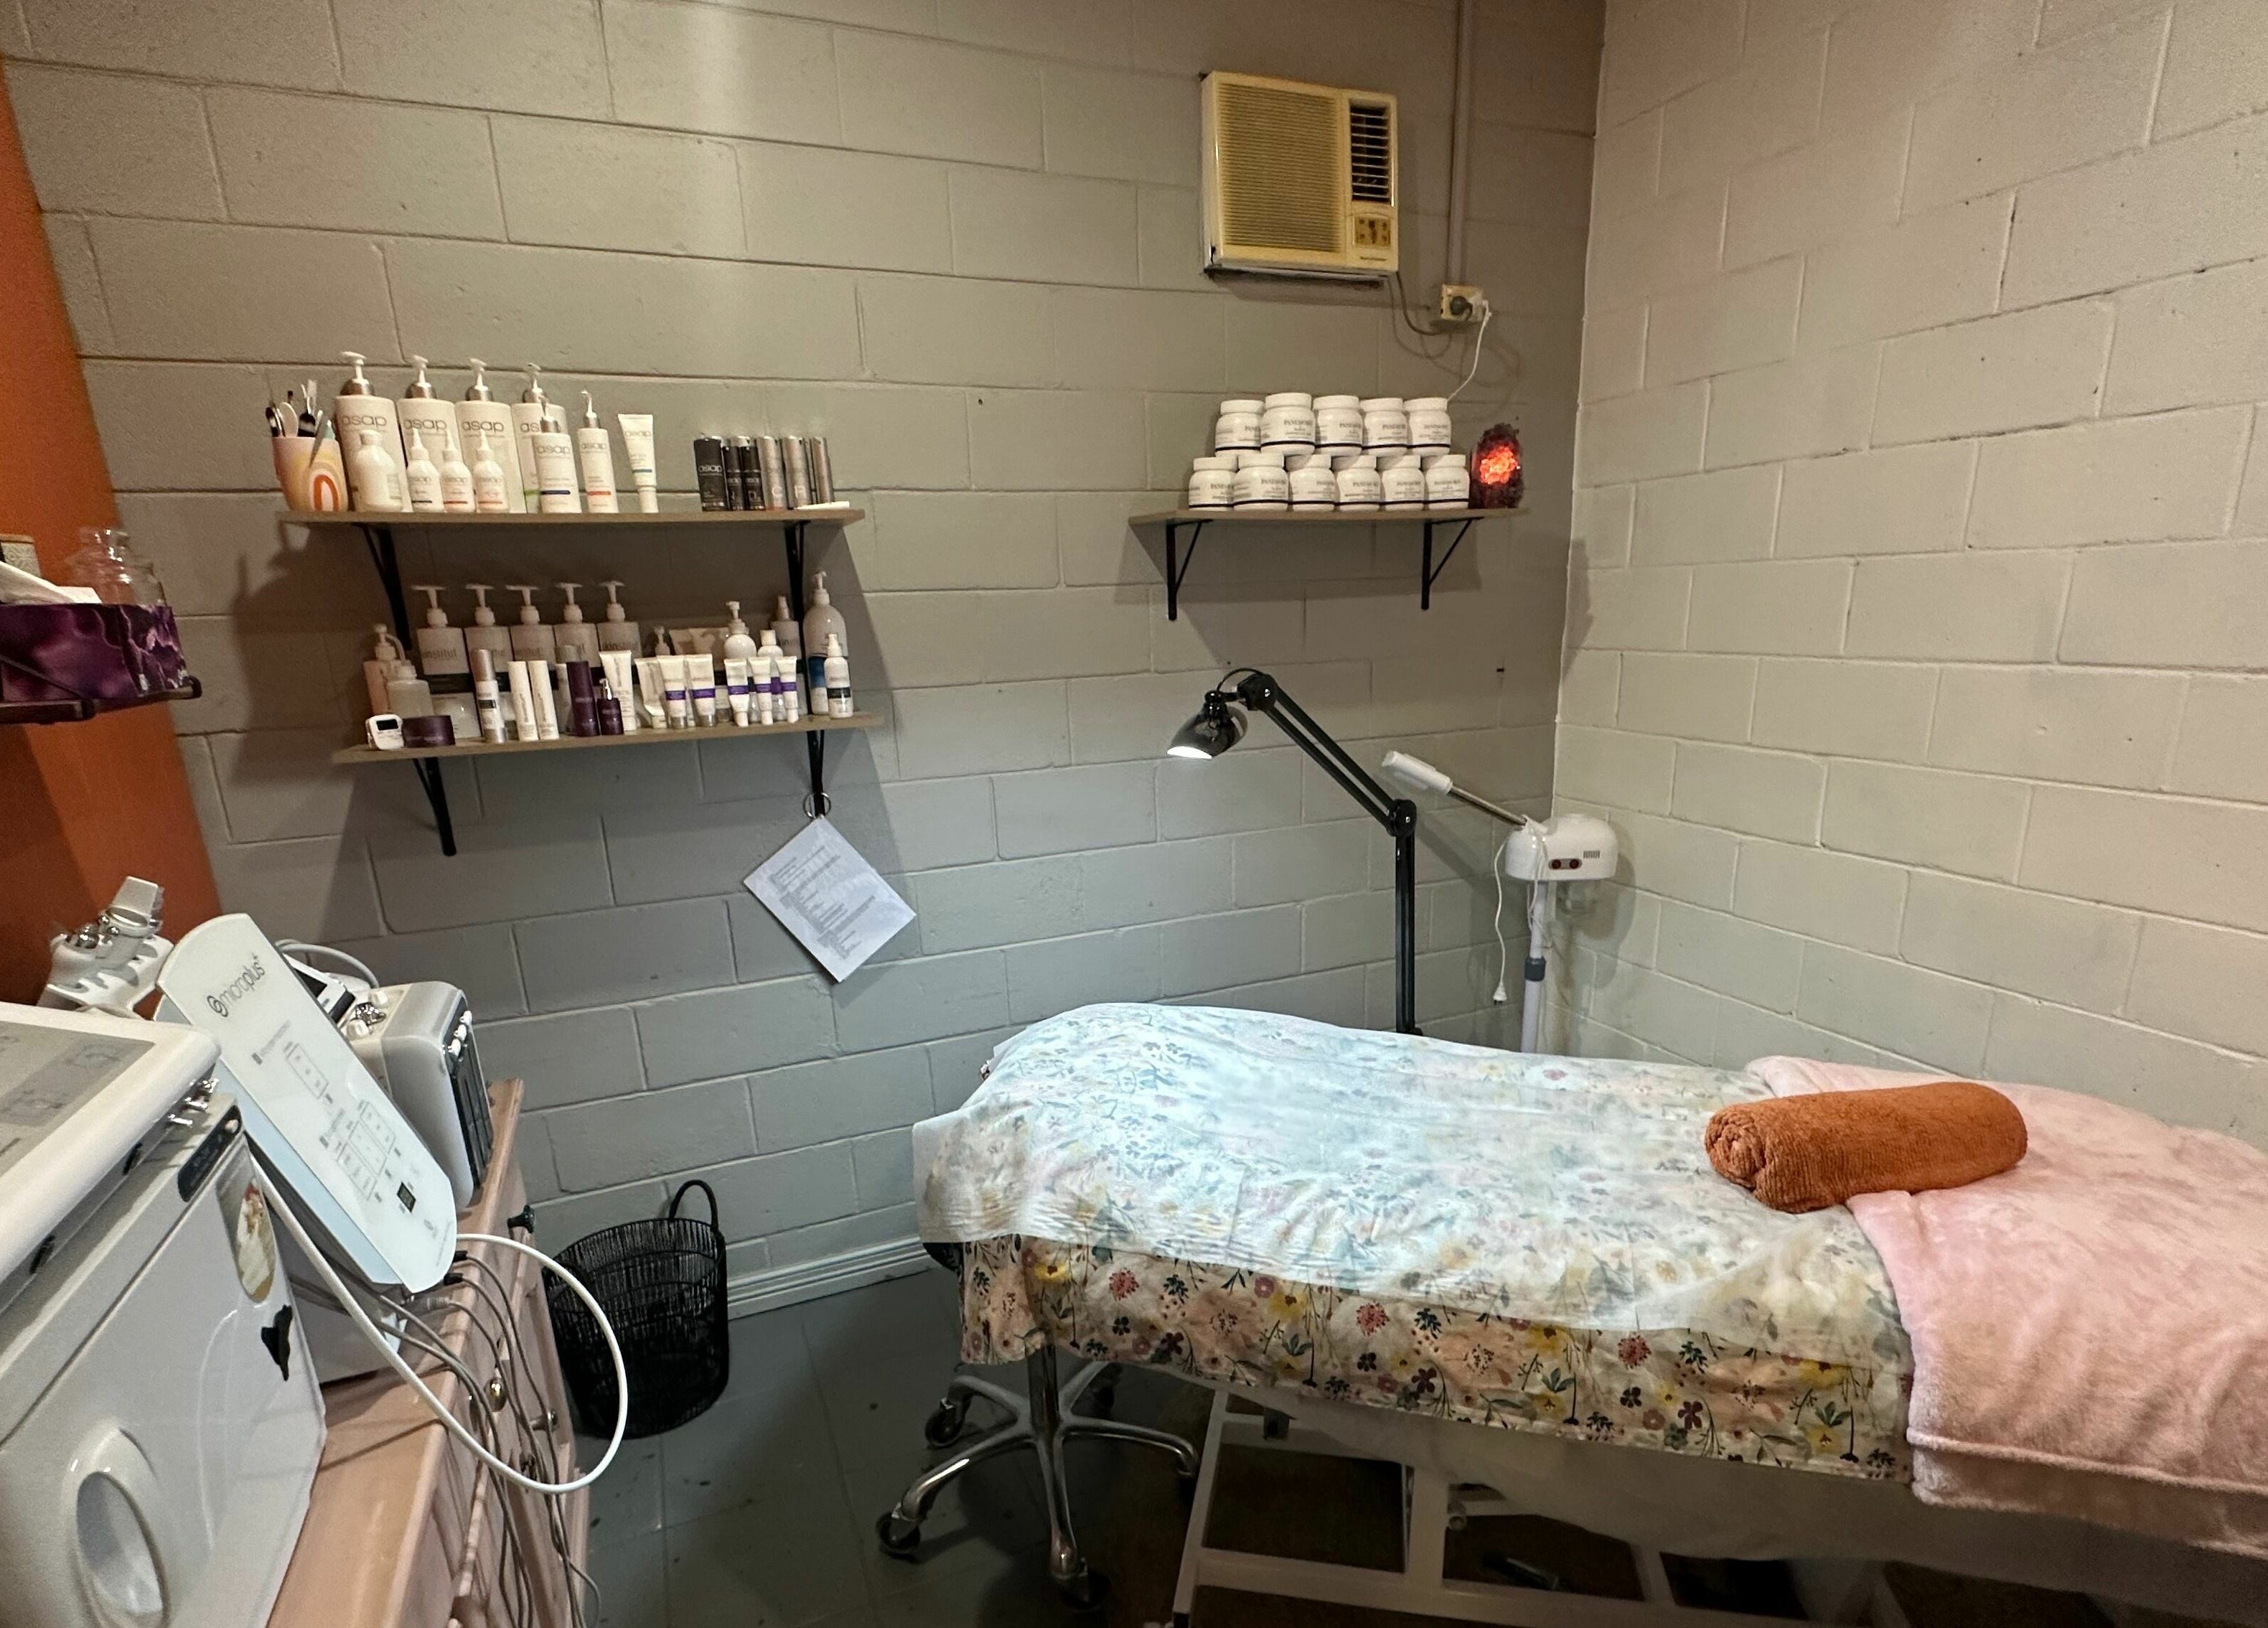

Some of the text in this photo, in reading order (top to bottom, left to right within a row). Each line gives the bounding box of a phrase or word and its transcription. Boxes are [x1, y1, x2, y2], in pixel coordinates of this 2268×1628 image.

[342, 416, 387, 429] asap
[403, 419, 447, 431] asap
[461, 421, 505, 433] asap
[520, 422, 540, 433] as
[538, 445, 571, 455] asap
